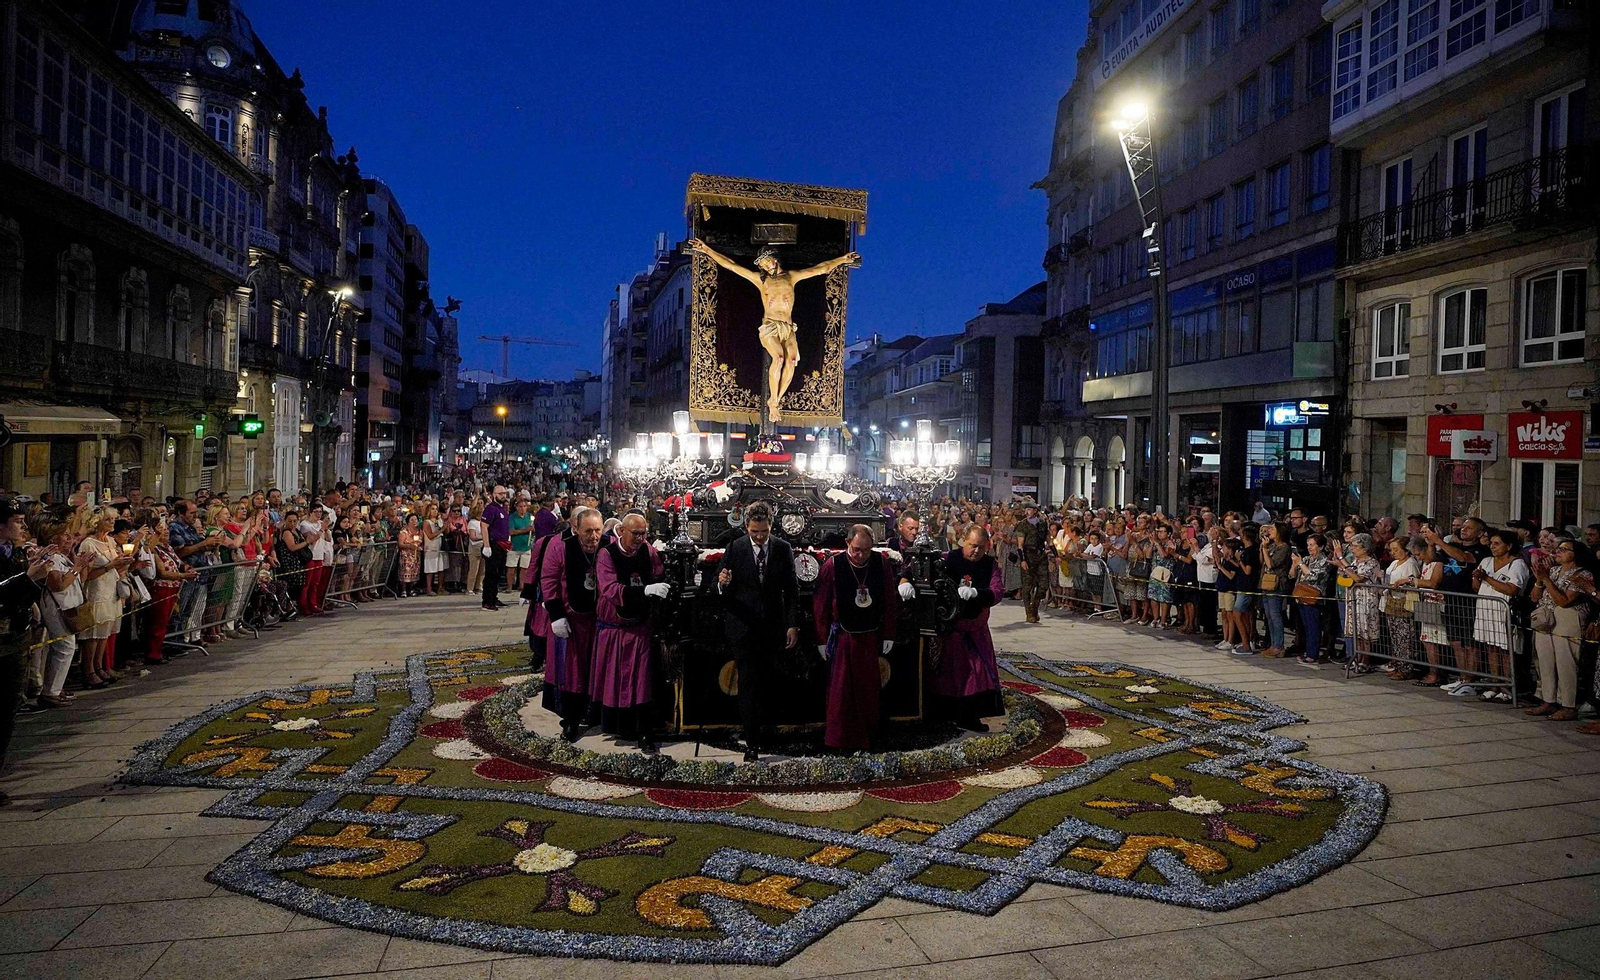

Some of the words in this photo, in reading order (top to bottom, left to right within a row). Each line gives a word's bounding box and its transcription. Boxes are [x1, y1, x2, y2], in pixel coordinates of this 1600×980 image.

[1111, 36, 1139, 69] EUDITA
[1226, 272, 1256, 291] OCASO
[1516, 415, 1567, 443] Nikis
